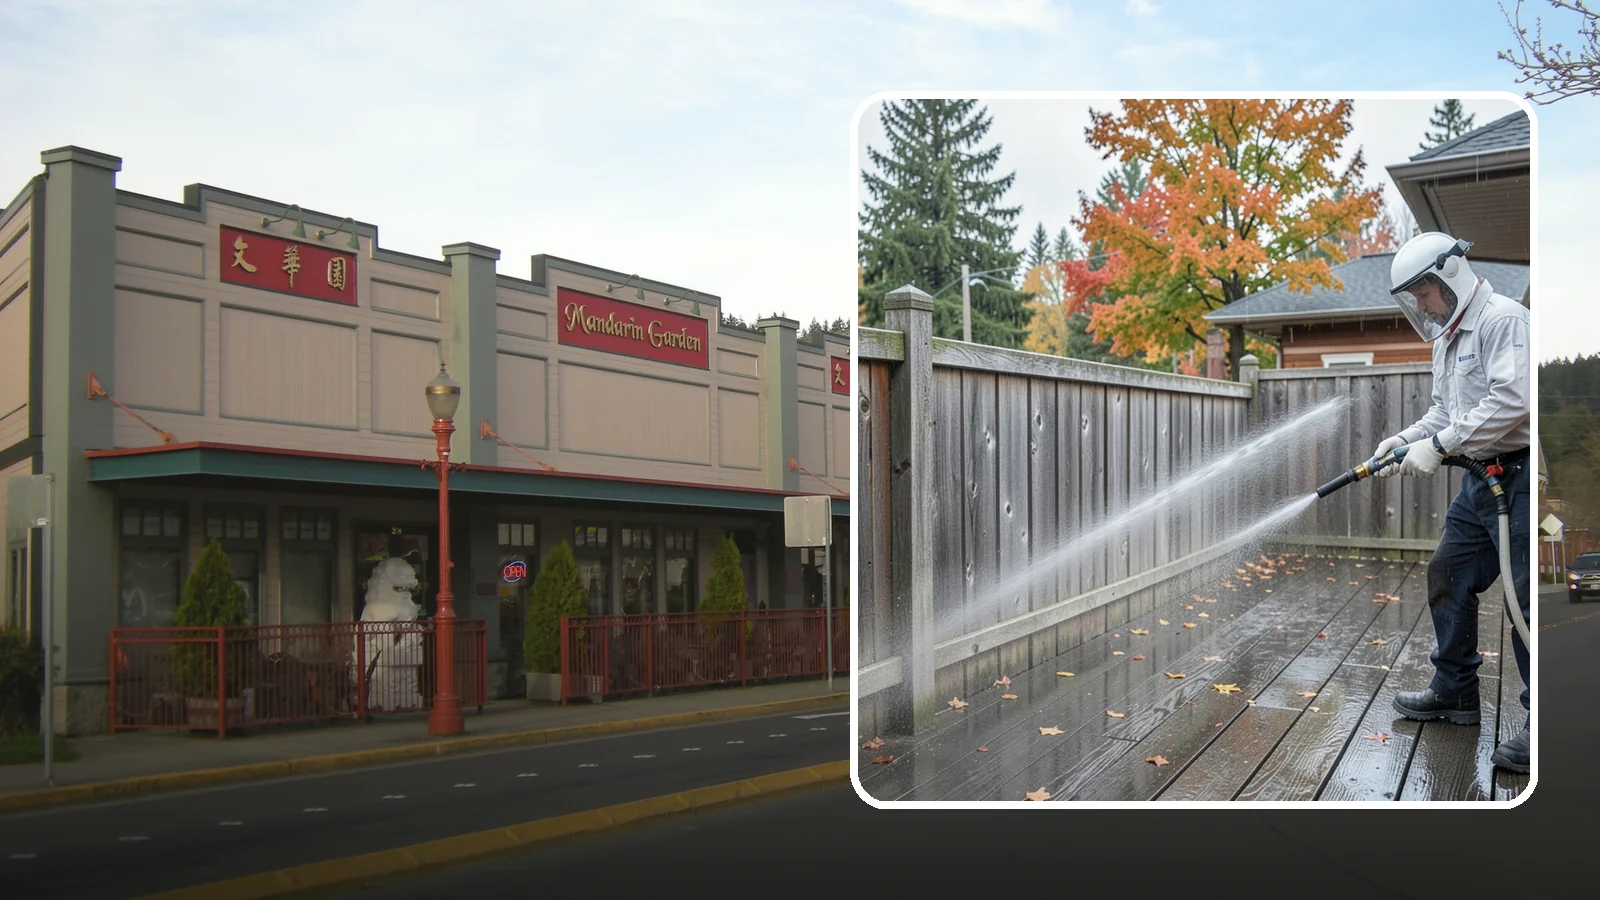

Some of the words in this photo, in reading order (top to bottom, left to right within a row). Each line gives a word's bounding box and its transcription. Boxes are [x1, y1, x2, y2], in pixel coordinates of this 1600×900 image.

[231, 236, 347, 291] 文華園
[564, 302, 644, 341] Mandarin
[647, 320, 701, 352] Garden
[503, 565, 527, 578] OPEN
